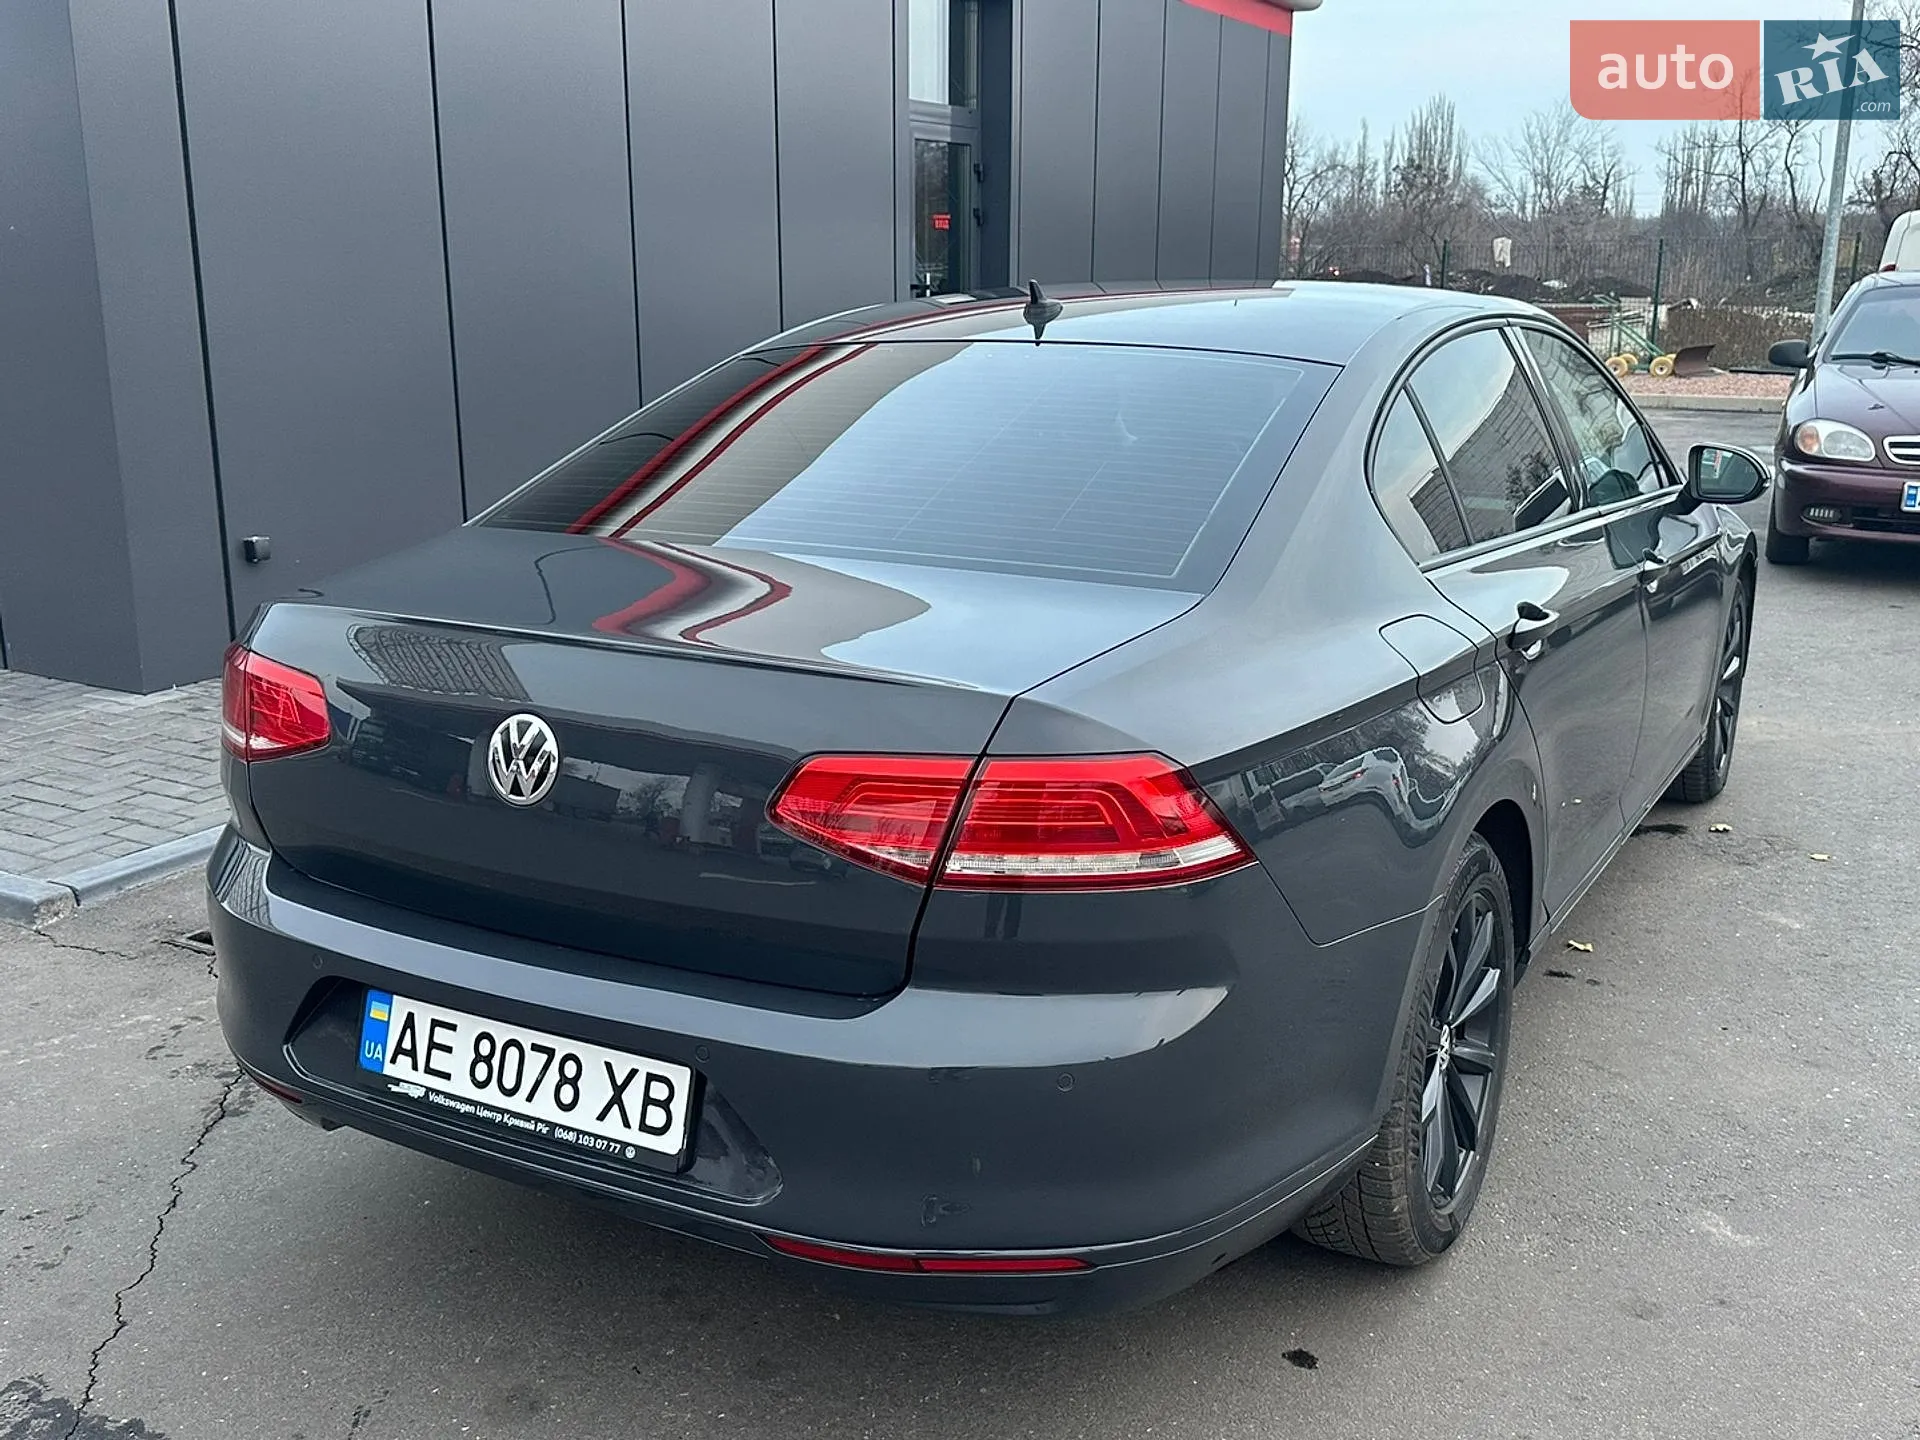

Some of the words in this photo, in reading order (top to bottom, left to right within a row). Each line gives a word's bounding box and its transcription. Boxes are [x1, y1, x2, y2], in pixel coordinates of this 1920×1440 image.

[365, 1040, 383, 1063] UA
[389, 1011, 458, 1081] AE
[469, 1031, 583, 1112] 8078
[595, 1060, 676, 1136] XB
[429, 1091, 476, 1114] Volkswagen
[476, 1105, 502, 1123] Центр
[554, 1126, 577, 1144] (068)
[578, 1134, 594, 1147] 103
[595, 1139, 608, 1151] 07
[608, 1143, 621, 1154] 77
